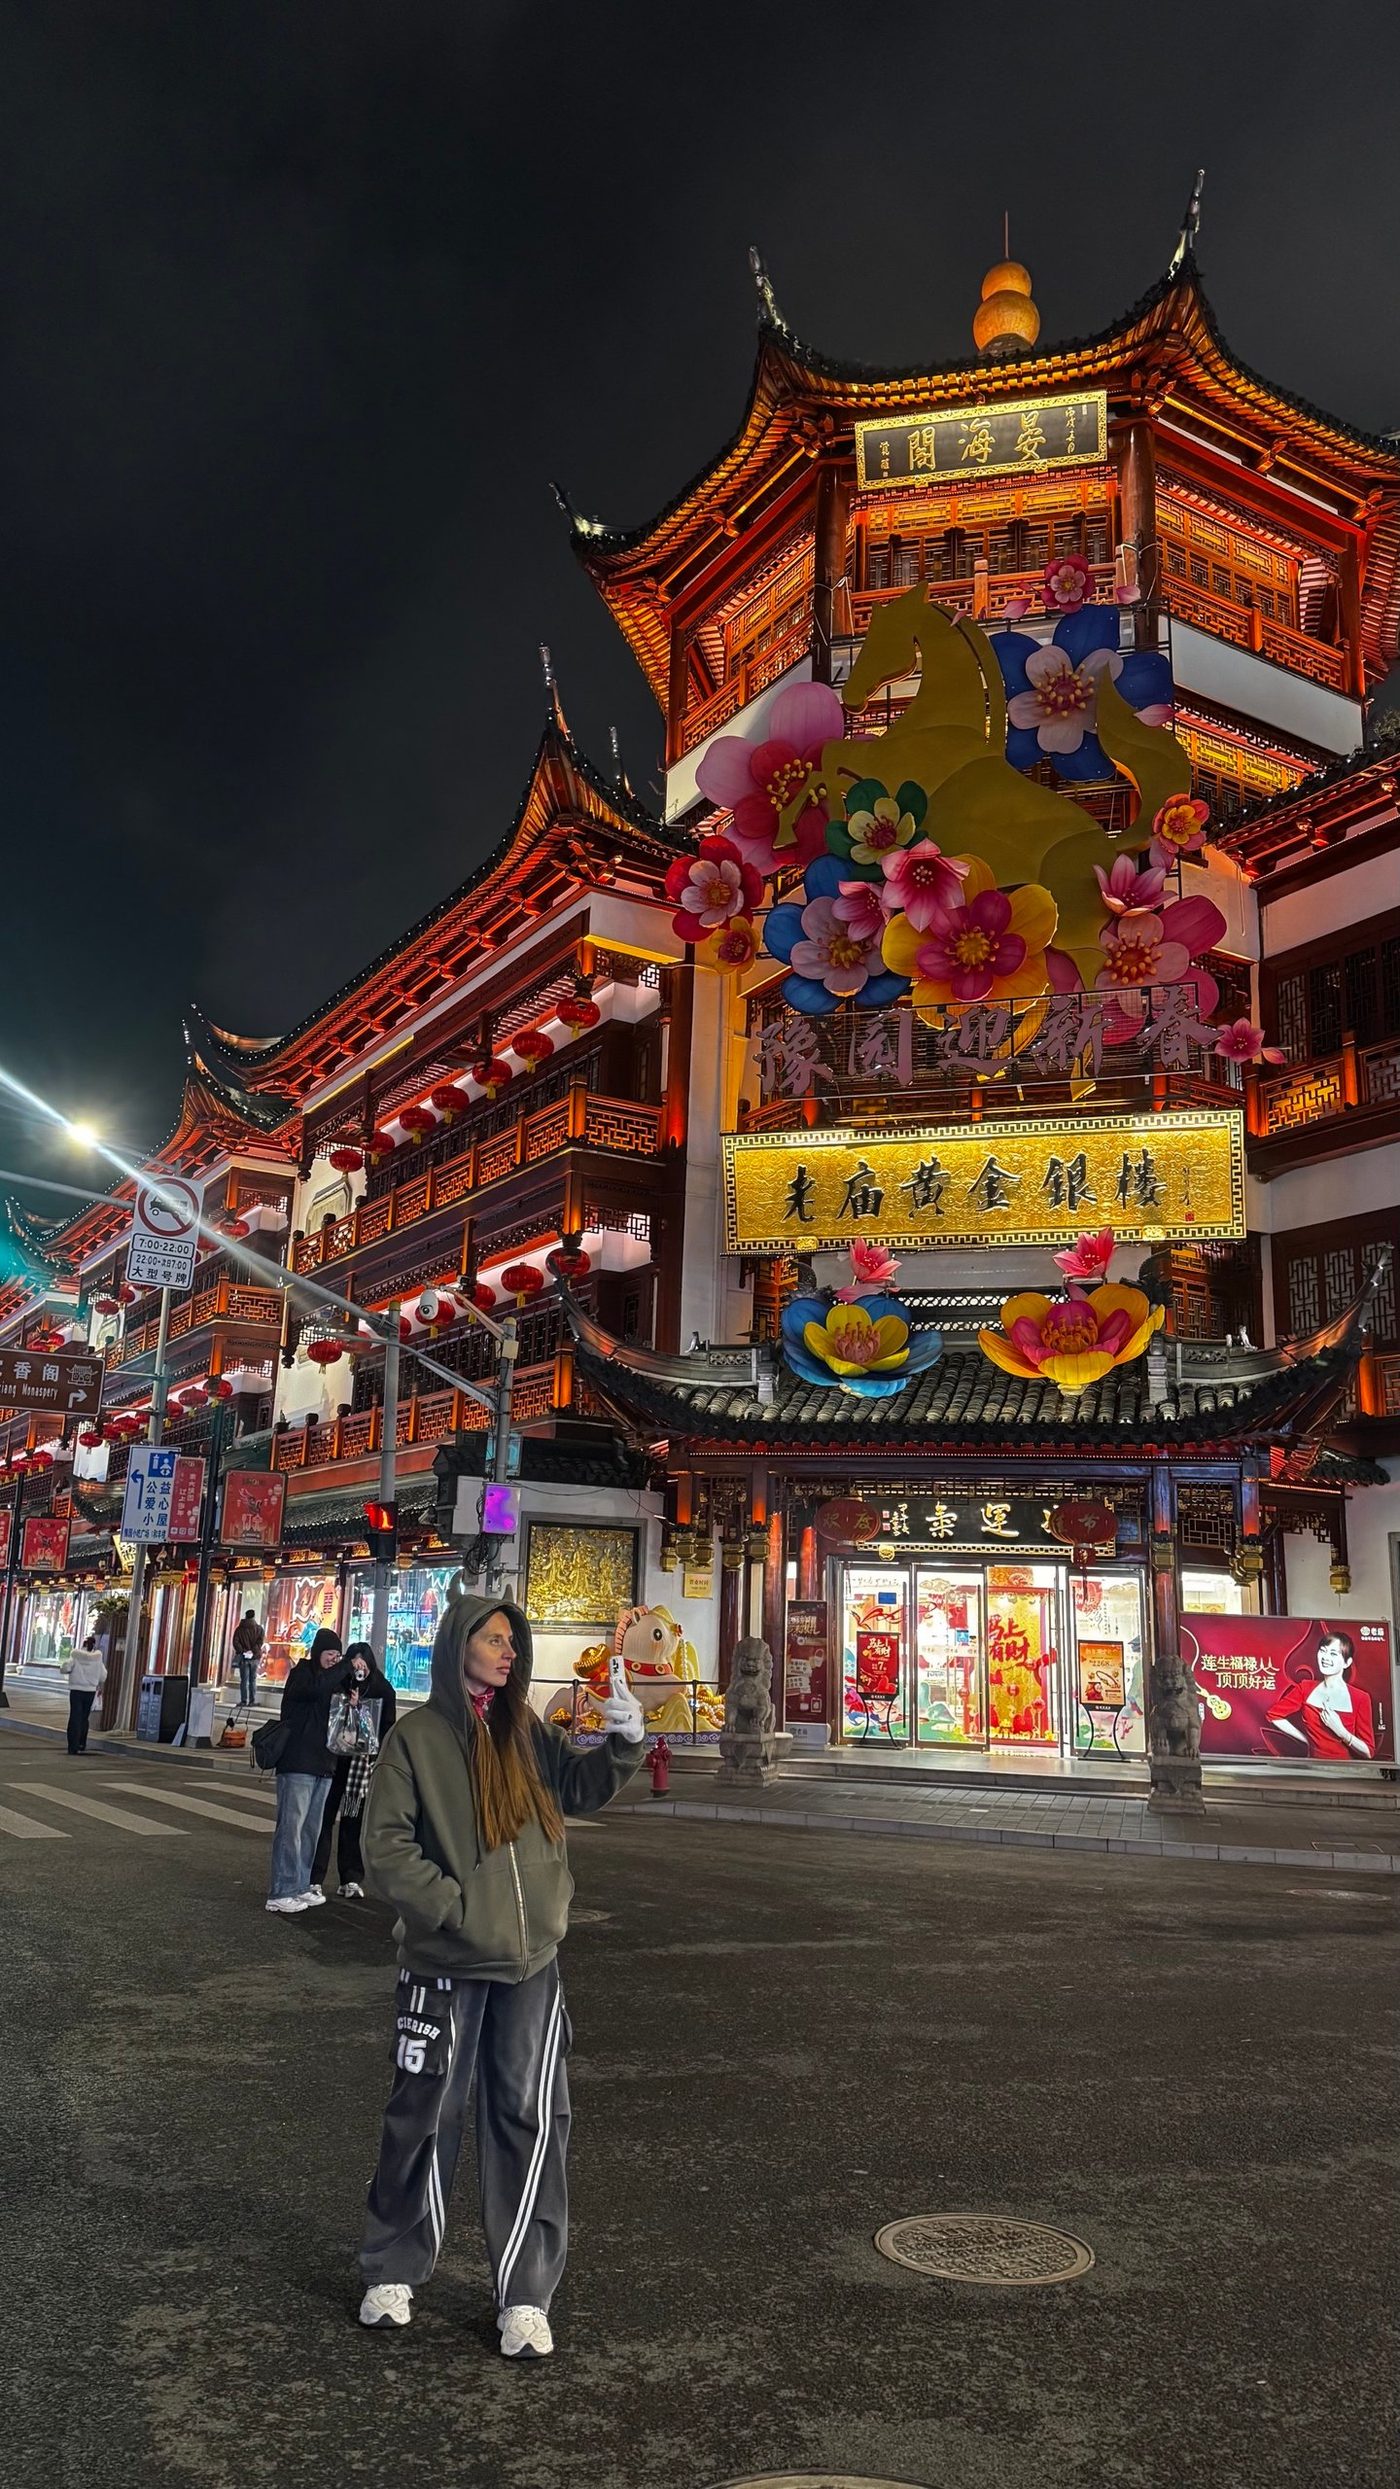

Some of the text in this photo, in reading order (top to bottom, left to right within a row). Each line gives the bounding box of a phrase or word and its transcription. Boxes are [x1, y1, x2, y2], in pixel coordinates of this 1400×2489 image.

[753, 983, 1225, 1099] 豫园迎新春
[139, 1238, 190, 1255] 7:00-22:00
[131, 1266, 187, 1284] 大型号牌
[0, 1361, 60, 1382] 香阁
[146, 1480, 172, 1495] 公益
[144, 1496, 169, 1510] 爱心
[143, 1512, 168, 1527] 小屋
[925, 1501, 1058, 1538] 運氣
[989, 1636, 1030, 1662] 有财
[1215, 1671, 1276, 1690] 顶顶好运
[397, 2034, 427, 2074] 15
